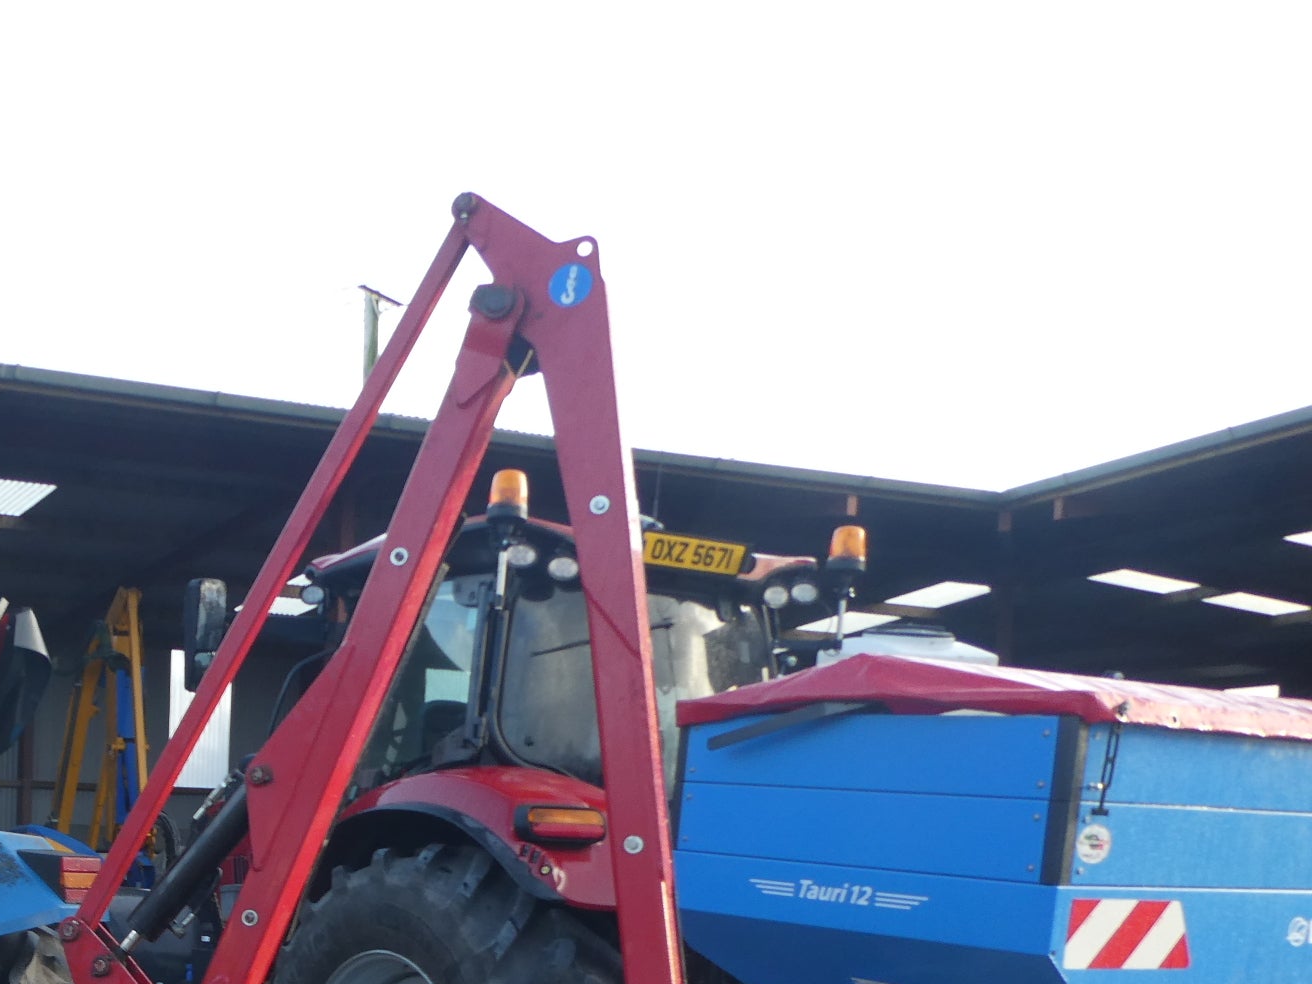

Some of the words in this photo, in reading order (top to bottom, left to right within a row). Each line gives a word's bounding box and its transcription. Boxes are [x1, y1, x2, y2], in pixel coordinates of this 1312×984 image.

[651, 539, 690, 563] OXZ
[691, 544, 734, 569] 5671
[799, 879, 849, 903] Tauri
[849, 885, 873, 906] 12
